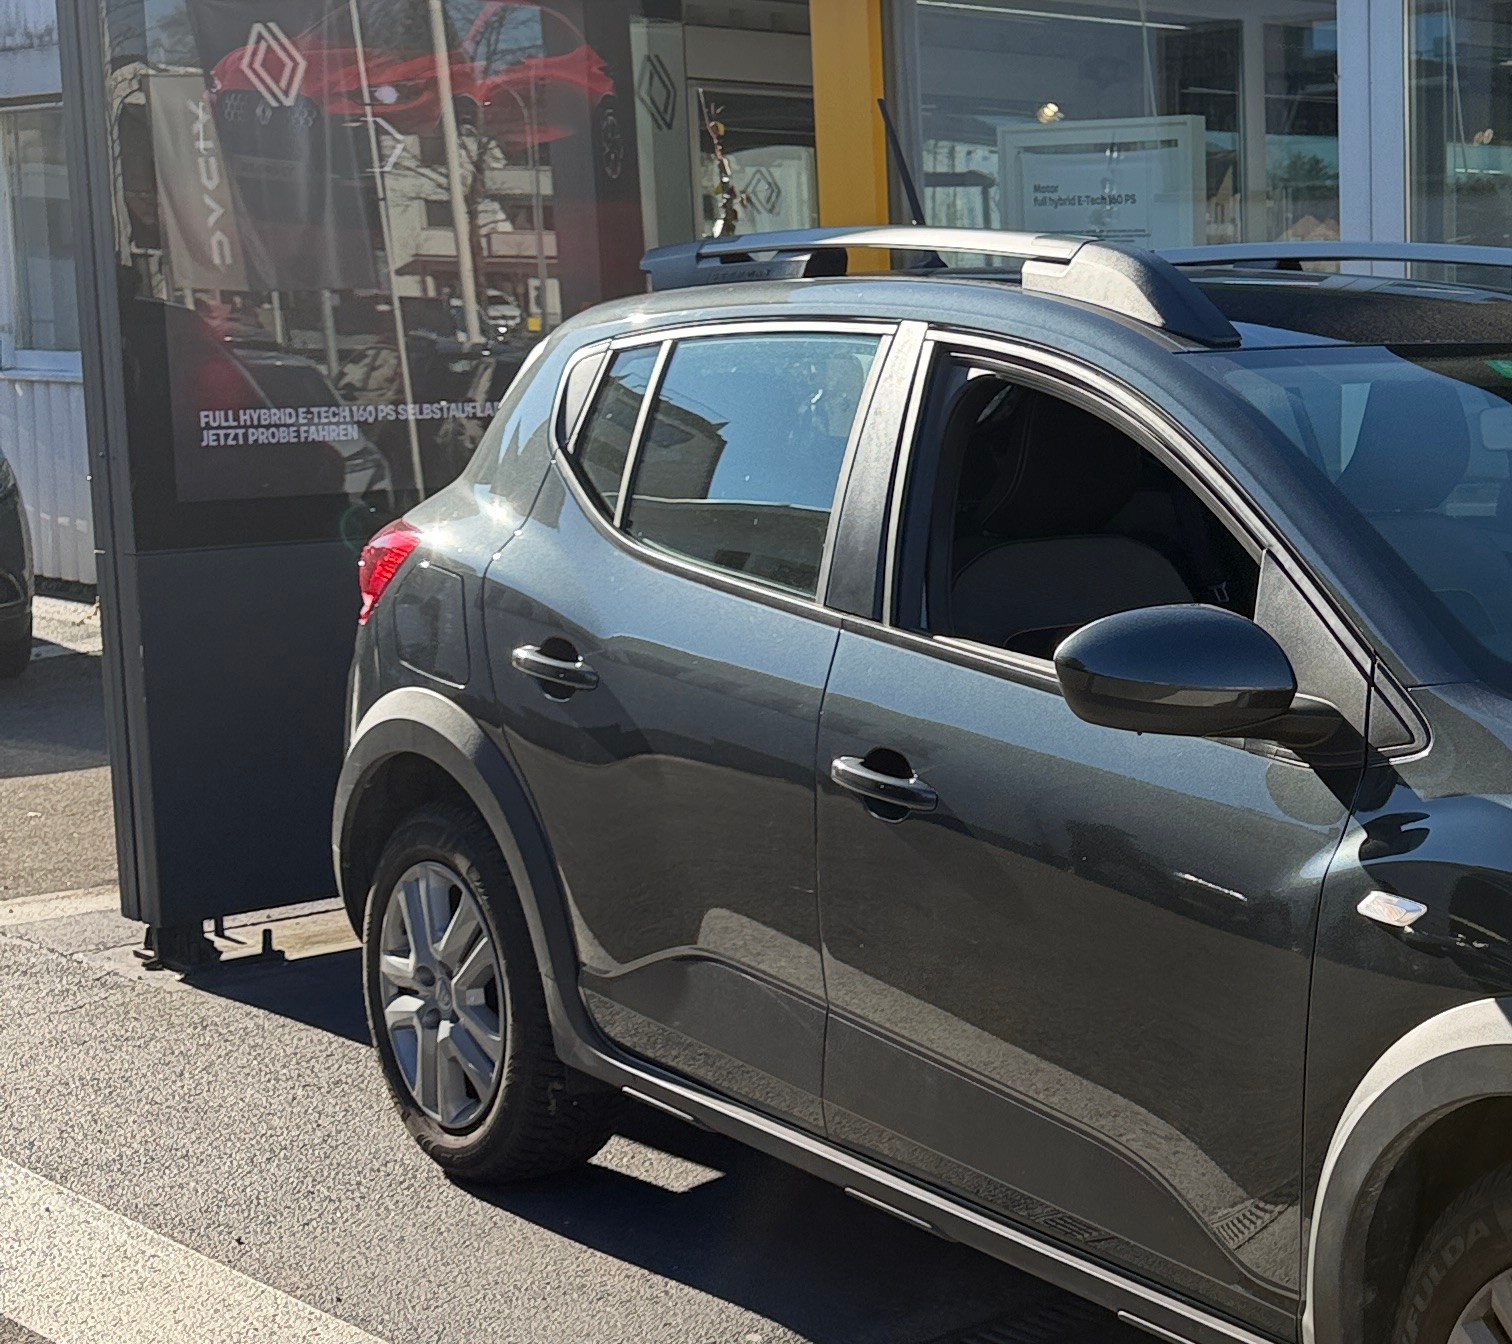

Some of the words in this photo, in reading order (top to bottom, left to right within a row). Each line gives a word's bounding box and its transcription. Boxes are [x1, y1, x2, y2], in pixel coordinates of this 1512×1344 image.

[1124, 193, 1137, 204] PS
[200, 410, 238, 428] FULL
[239, 408, 297, 426] HYBRID
[298, 406, 350, 424] E-TECH
[352, 405, 376, 423] 160
[378, 404, 397, 421] PS
[201, 428, 246, 447] JETZT
[247, 427, 298, 444] PROBE
[299, 424, 359, 442] FAHREN
